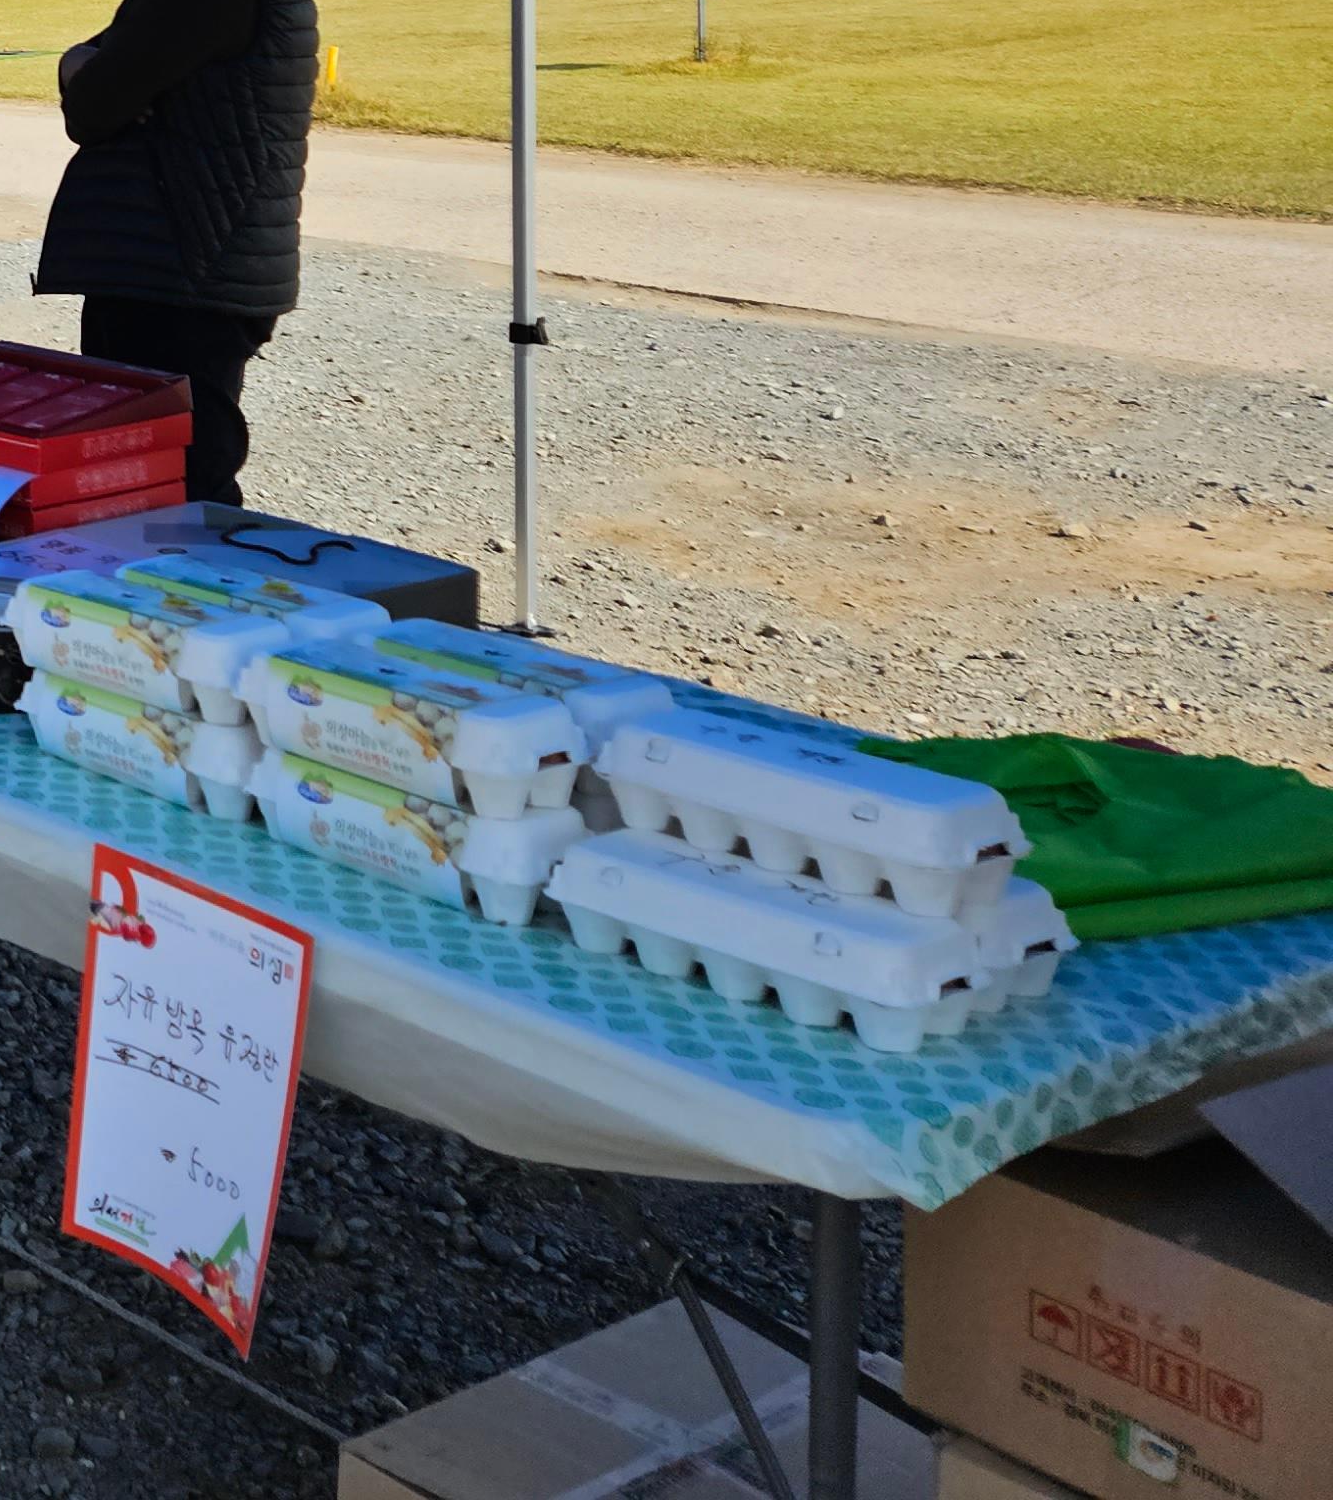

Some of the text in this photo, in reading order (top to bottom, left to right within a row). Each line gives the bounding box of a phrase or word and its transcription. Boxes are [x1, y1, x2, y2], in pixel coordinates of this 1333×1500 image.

[248, 947, 284, 985] 의성
[149, 1055, 210, 1093] 6500
[219, 1024, 279, 1084] 유정란
[188, 1146, 241, 1200] 5000
